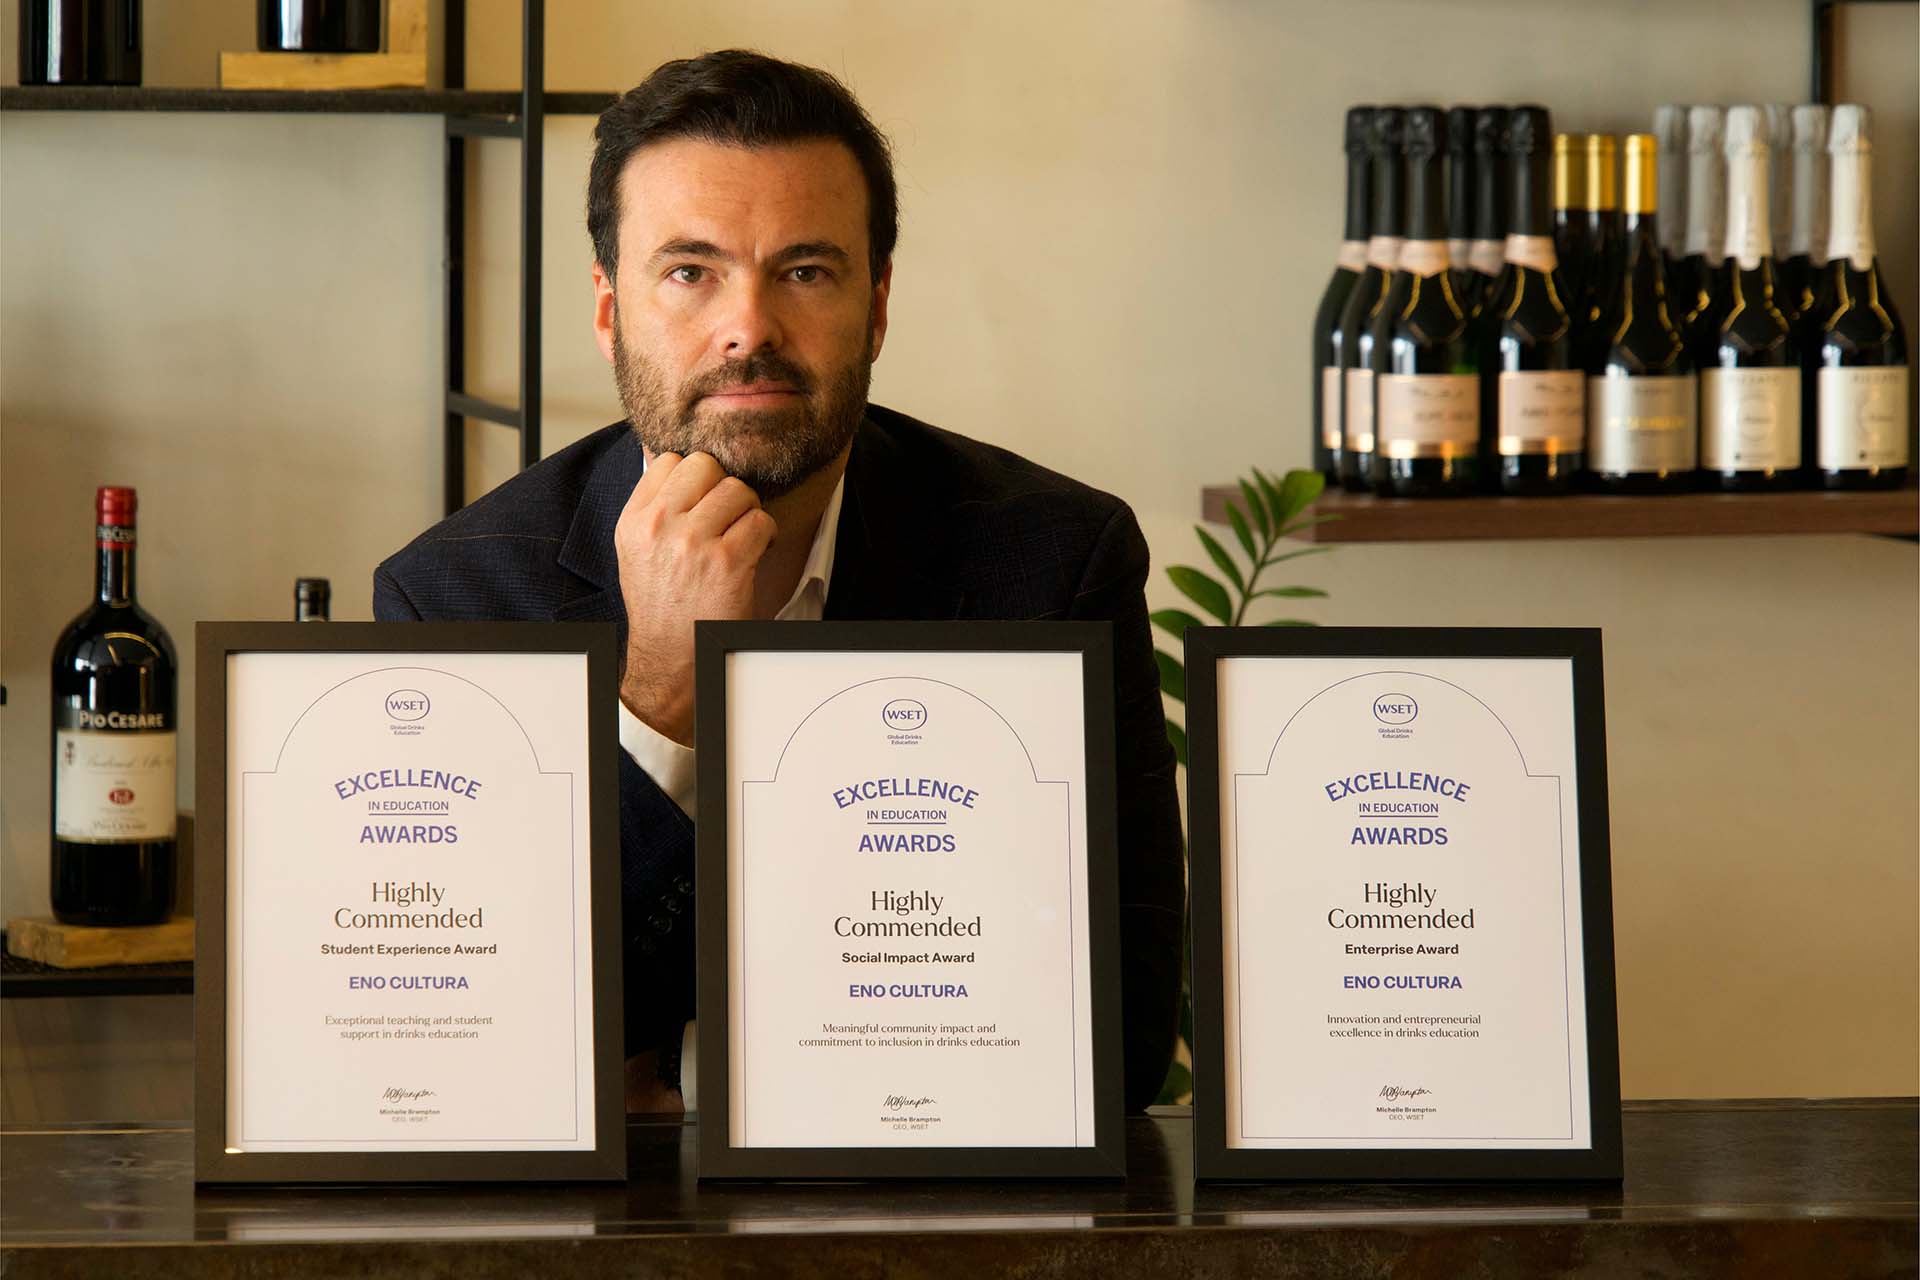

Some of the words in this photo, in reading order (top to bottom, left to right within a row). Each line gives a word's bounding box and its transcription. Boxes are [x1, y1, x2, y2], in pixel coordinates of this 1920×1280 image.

[390, 700, 425, 710] WSET
[1377, 704, 1414, 714] WSET
[887, 710, 922, 720] WSET
[334, 769, 482, 800] EXCELLENCE
[1324, 772, 1471, 803] EXCELLENCE
[832, 778, 979, 809] EXCELLENCE
[369, 801, 380, 810] IN
[383, 801, 449, 810] EDUCATION
[1359, 803, 1370, 812] IN
[1374, 803, 1438, 813] EDUCATION
[867, 810, 878, 819] IN
[882, 810, 946, 820] EDUCATION
[360, 825, 457, 843] AWARDS
[1351, 827, 1448, 845] AWARDS
[859, 834, 955, 852] AWARDS
[373, 882, 445, 907] Highly
[1365, 883, 1436, 908] Highly
[872, 890, 943, 916] Highly
[334, 907, 483, 928] Commended
[1328, 908, 1475, 929] Commended
[834, 916, 981, 937] Commended
[321, 944, 374, 954] Student
[377, 944, 451, 956] Experience
[454, 944, 496, 954] Award
[1345, 944, 1413, 956] Enterprise
[1416, 944, 1459, 954] Award
[842, 952, 881, 963] Social
[884, 953, 929, 965] Impact
[932, 952, 974, 963] Award
[350, 976, 386, 989] ENO
[390, 976, 469, 989] CULTURA
[1344, 976, 1380, 989] ENO
[1384, 976, 1462, 989] CULTURA
[850, 985, 886, 997] ENO
[889, 985, 968, 997] CULTURA
[325, 1016, 384, 1027] Exceptional
[387, 1016, 431, 1027] teaching
[432, 1016, 452, 1024] and
[454, 1016, 493, 1025] student
[1328, 1014, 1380, 1024] Innovation
[1383, 1014, 1401, 1024] and
[1404, 1014, 1481, 1026] entrepreneurial
[340, 1031, 381, 1040] support
[382, 1029, 392, 1039] in
[394, 1029, 426, 1039] drinks
[428, 1029, 478, 1039] education
[823, 1024, 878, 1035] Meaningful
[881, 1024, 937, 1035] community
[940, 1024, 974, 1035] impact
[977, 1024, 995, 1033] and
[1330, 1028, 1381, 1037] excellence
[1384, 1028, 1393, 1037] in
[1396, 1028, 1427, 1037] drinks
[1429, 1028, 1479, 1038] education
[799, 1037, 862, 1047] commitment
[878, 1037, 922, 1047] inclusion
[925, 1037, 934, 1046] in
[937, 1037, 967, 1047] drinks
[970, 1037, 1020, 1046] education
